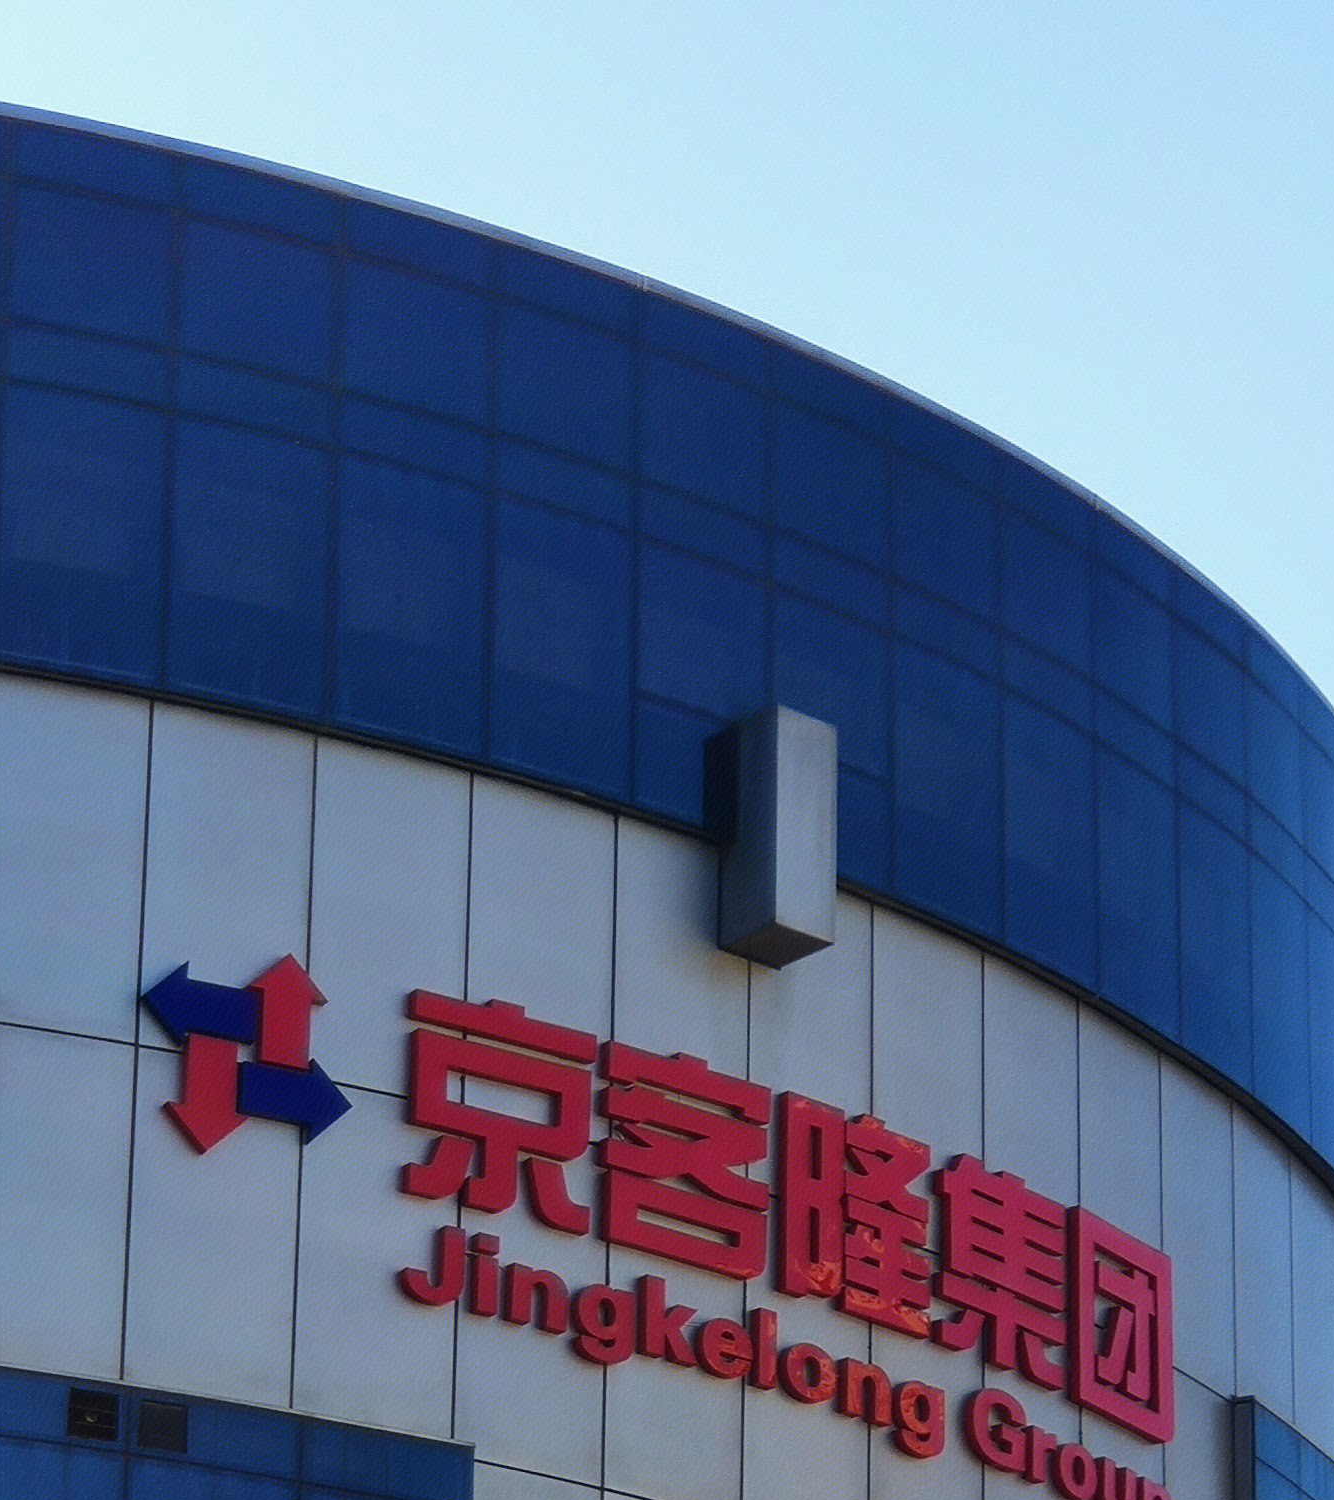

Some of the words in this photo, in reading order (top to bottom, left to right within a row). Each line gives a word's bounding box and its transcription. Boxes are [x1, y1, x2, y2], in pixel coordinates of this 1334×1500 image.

[400, 1225, 946, 1458] Jingkelong
[402, 989, 1175, 1444] 京客隆集团
